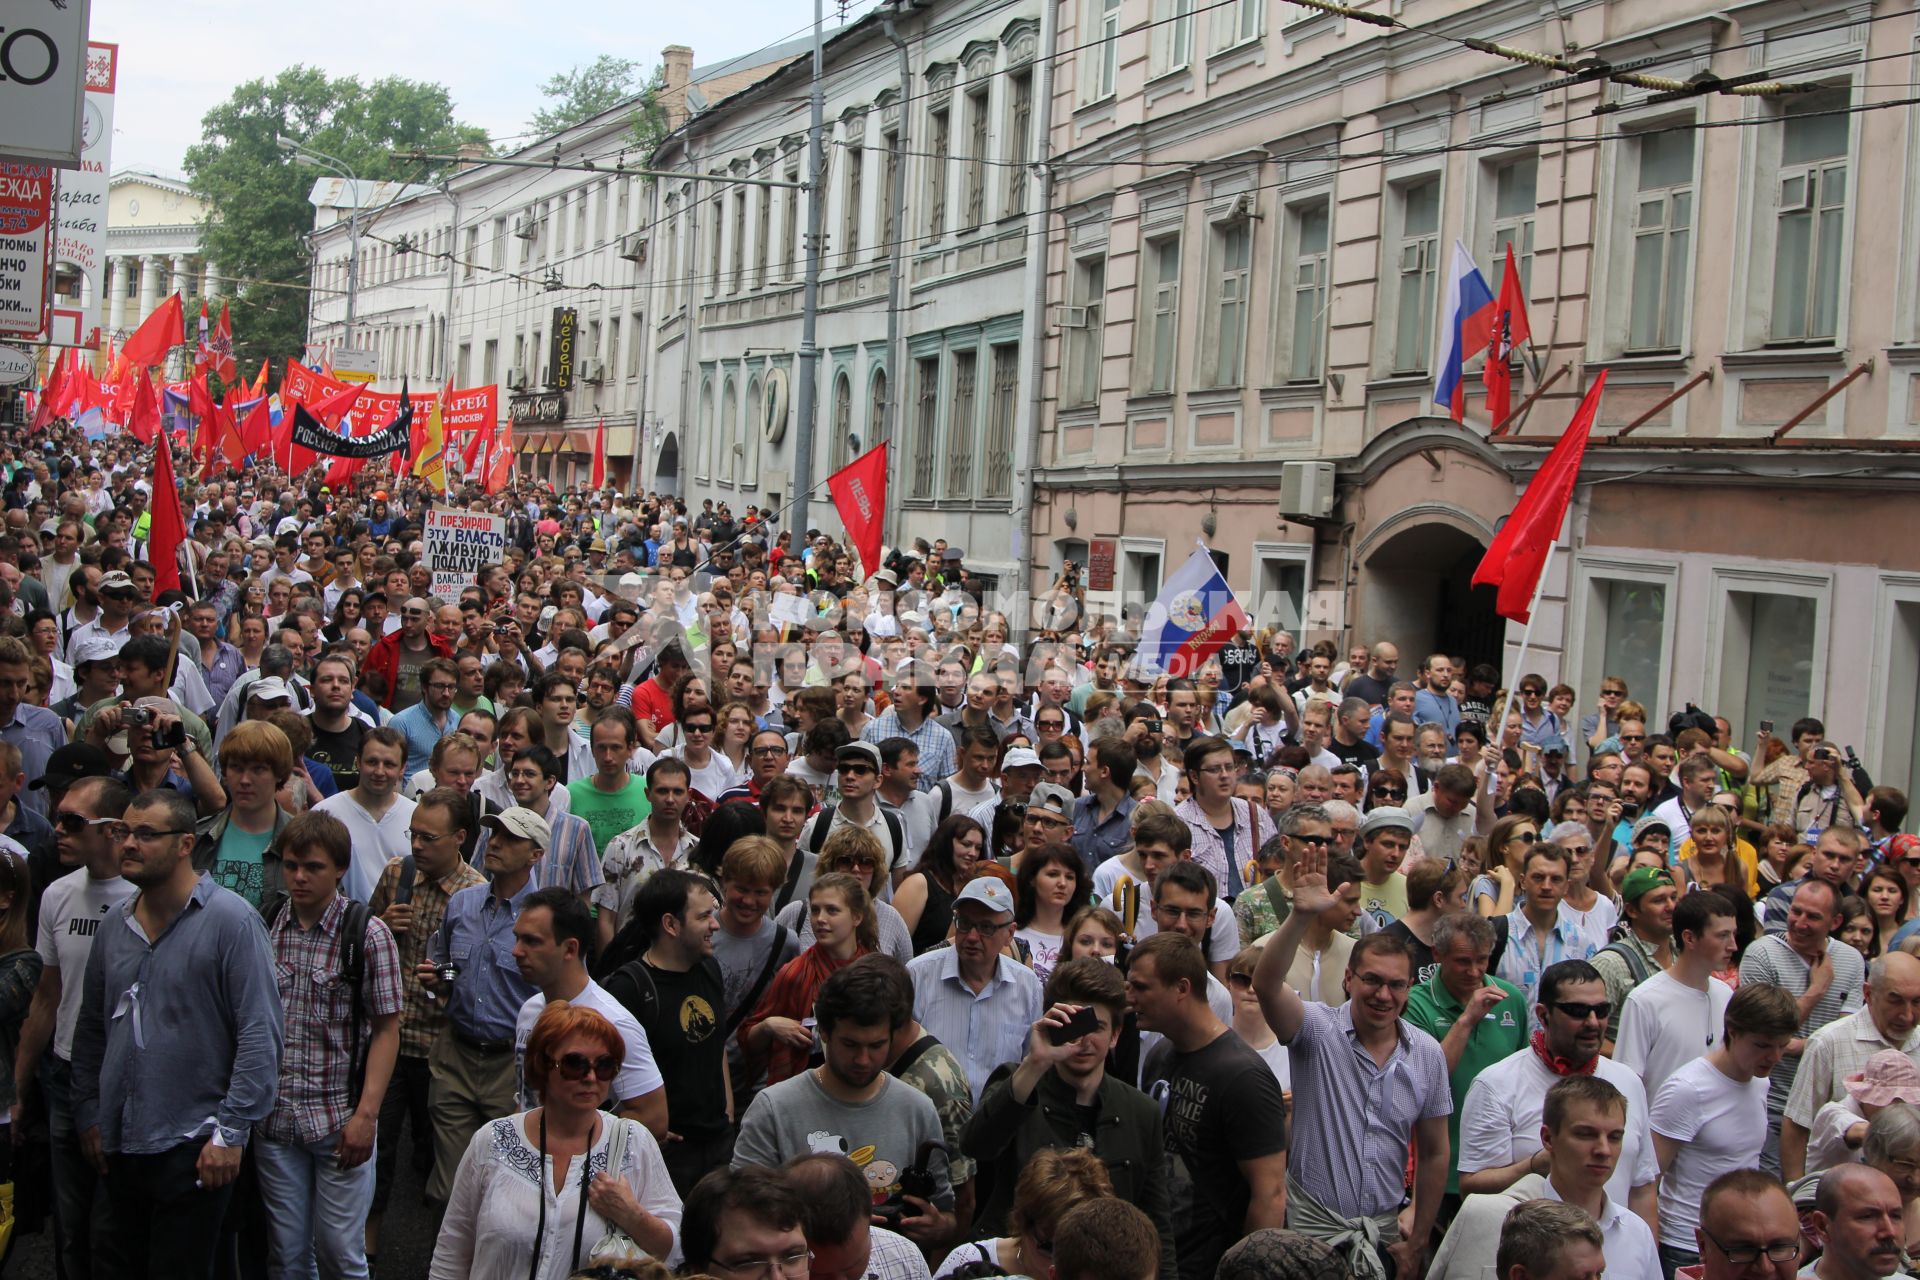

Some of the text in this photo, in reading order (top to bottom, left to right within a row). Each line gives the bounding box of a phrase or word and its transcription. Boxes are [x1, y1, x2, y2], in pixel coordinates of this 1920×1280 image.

[559, 312, 575, 388] Мебель
[427, 511, 492, 532] Я ПРЕЗИРАЮ
[427, 528, 450, 541] ЭТУ
[428, 540, 490, 560] ЛЖИВУЮ
[436, 573, 465, 585] ВЛАСТЬ
